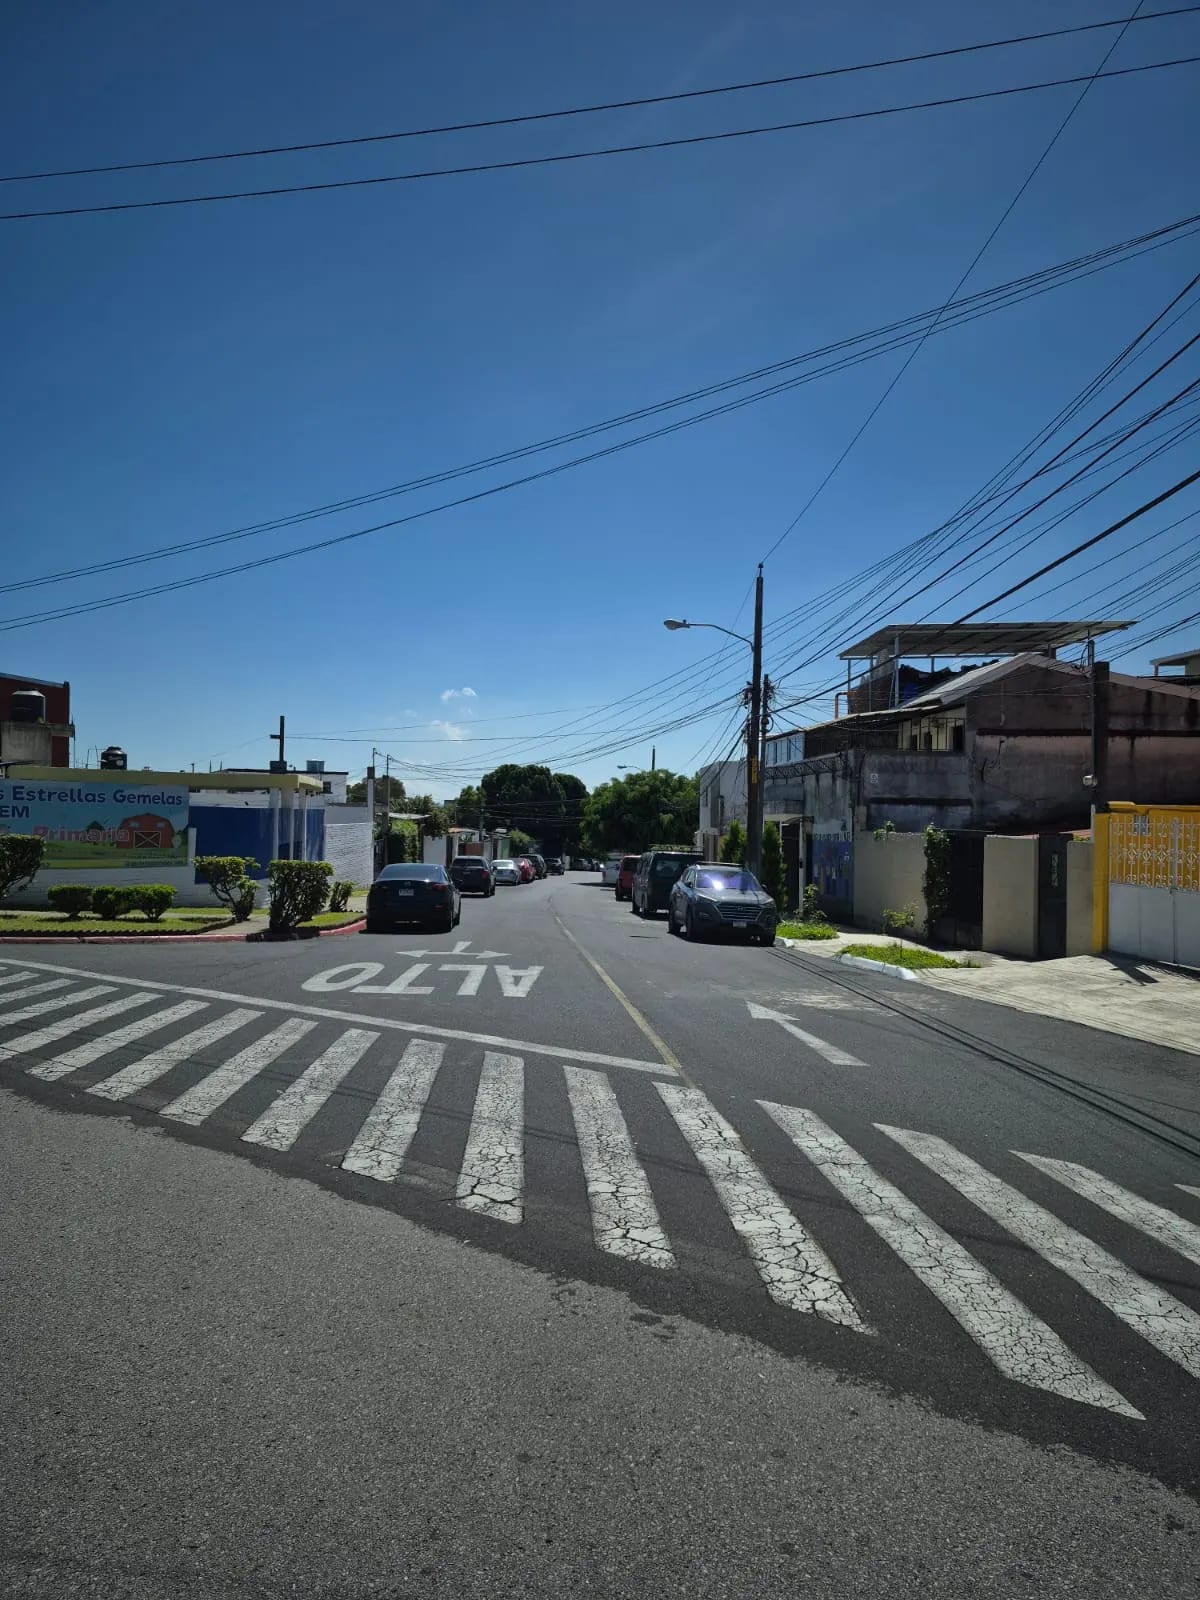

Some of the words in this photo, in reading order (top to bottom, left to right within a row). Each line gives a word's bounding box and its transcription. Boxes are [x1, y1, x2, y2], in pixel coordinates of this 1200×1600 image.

[12, 785, 106, 803] Estrellas
[113, 788, 183, 806] Gemelas
[301, 962, 545, 997] ALTO
